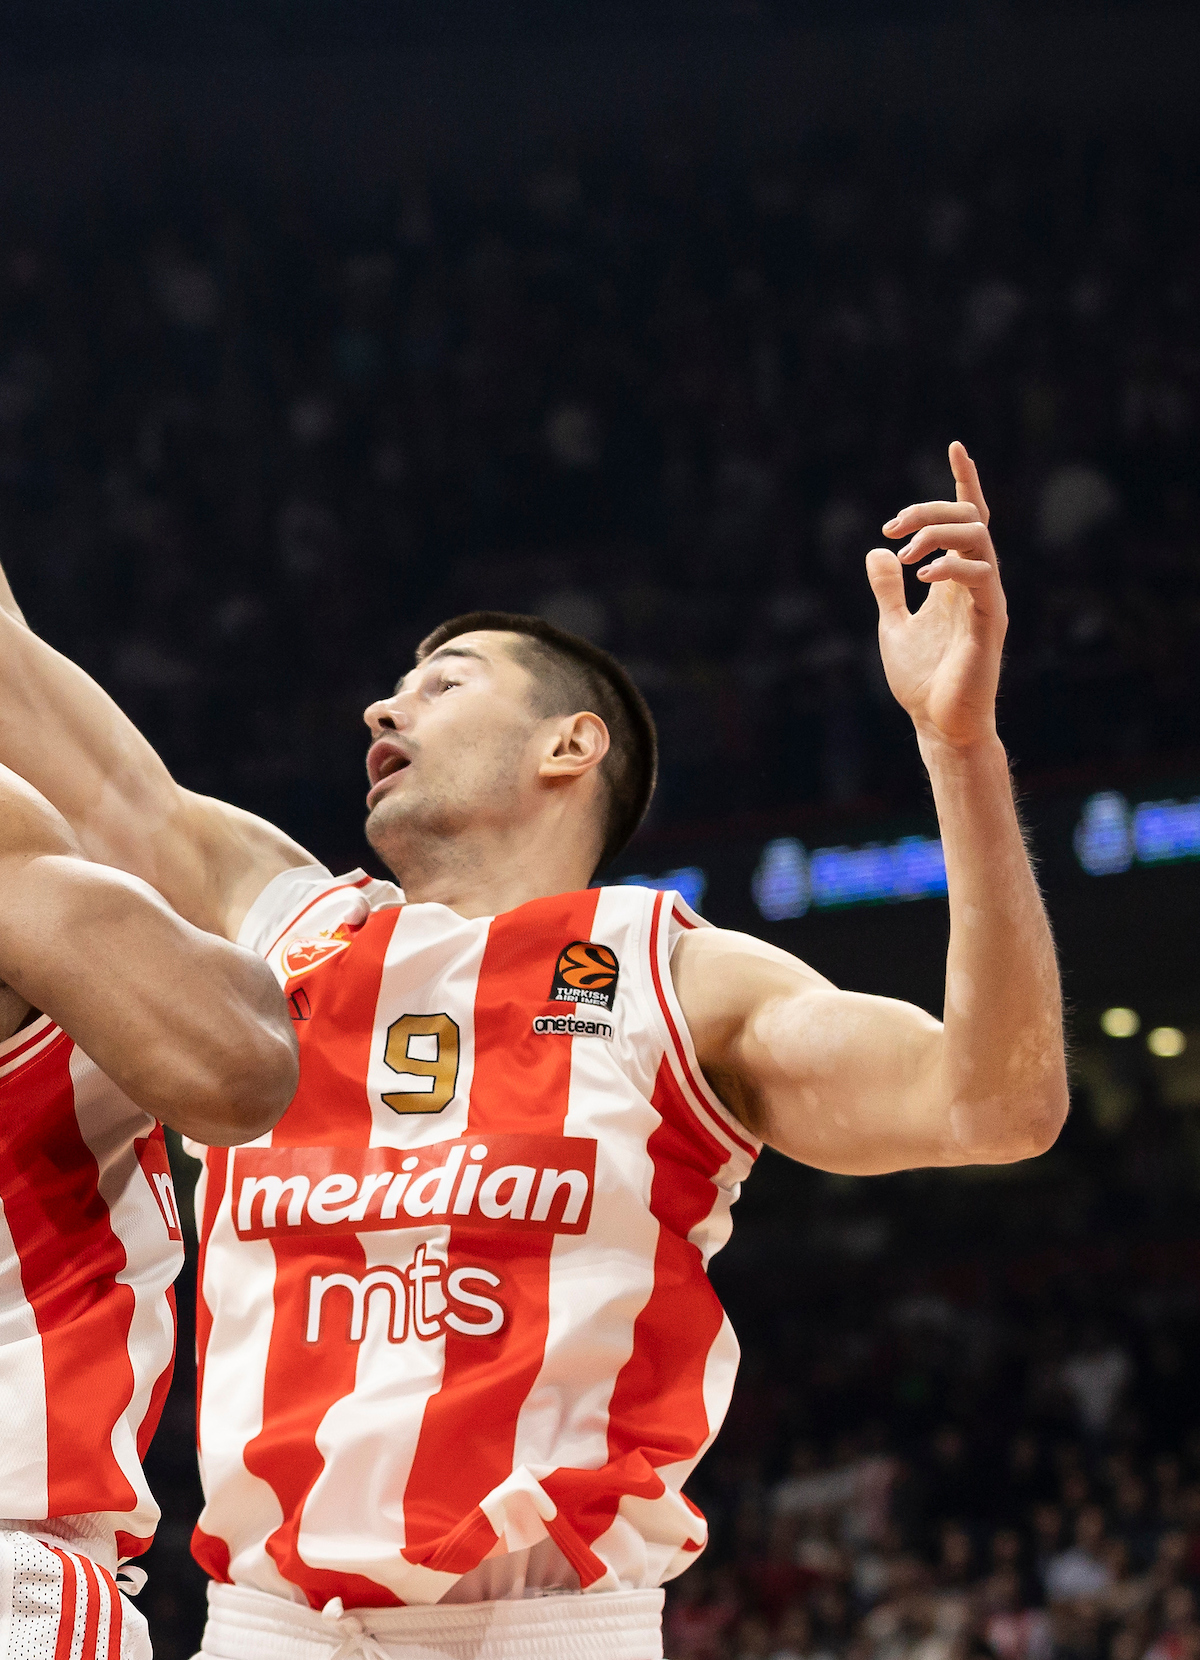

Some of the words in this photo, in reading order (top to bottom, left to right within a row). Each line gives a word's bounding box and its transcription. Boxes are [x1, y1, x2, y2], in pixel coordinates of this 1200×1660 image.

[534, 1015, 613, 1038] oneteam
[556, 987, 610, 1003] TURKISH
[381, 1012, 460, 1115] 9
[237, 1143, 589, 1232] meridian
[306, 1246, 505, 1343] mts
